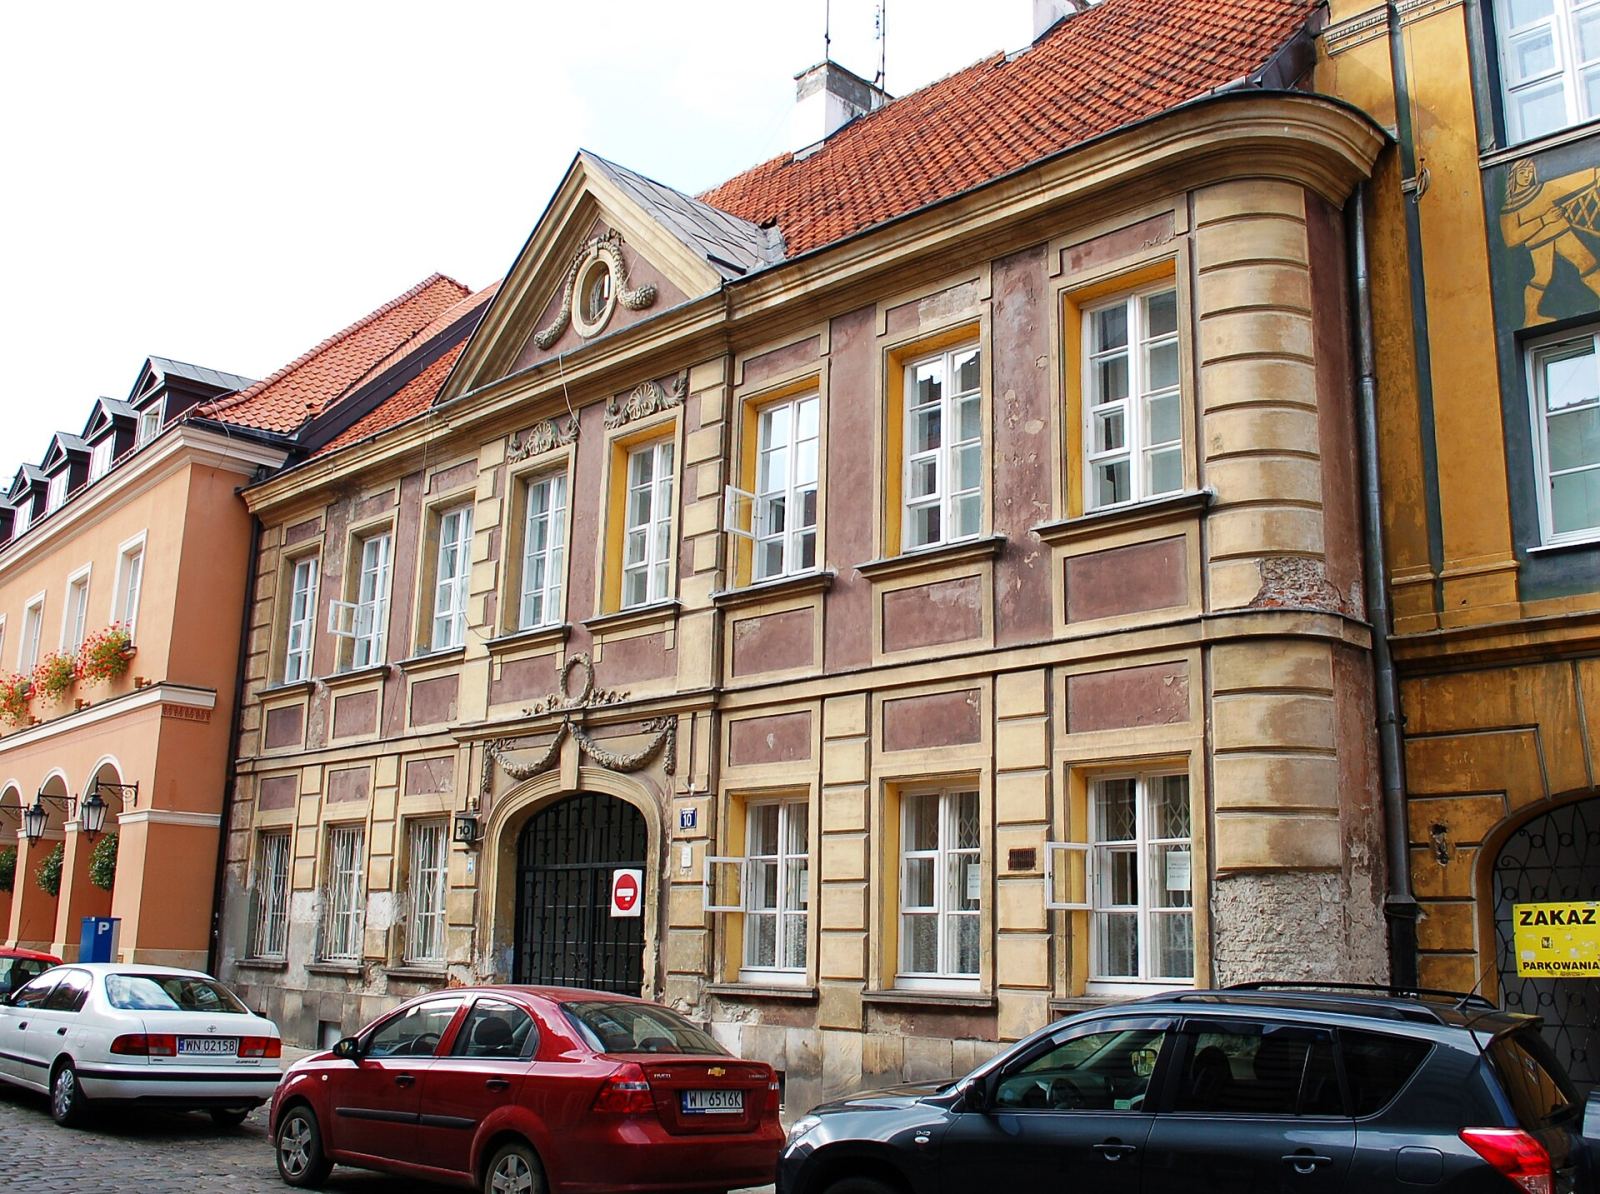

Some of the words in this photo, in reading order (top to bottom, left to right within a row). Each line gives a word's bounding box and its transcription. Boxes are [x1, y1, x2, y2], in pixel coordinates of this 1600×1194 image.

[683, 814, 692, 826] 10
[457, 825, 470, 835] 10
[1519, 909, 1596, 926] ZAKAZ
[98, 921, 110, 935] P
[1522, 961, 1600, 970] PARKOWANIA
[185, 1038, 200, 1051] WN
[203, 1039, 235, 1051] 02158
[689, 1091, 703, 1107] WI
[708, 1092, 741, 1107] 6516K
